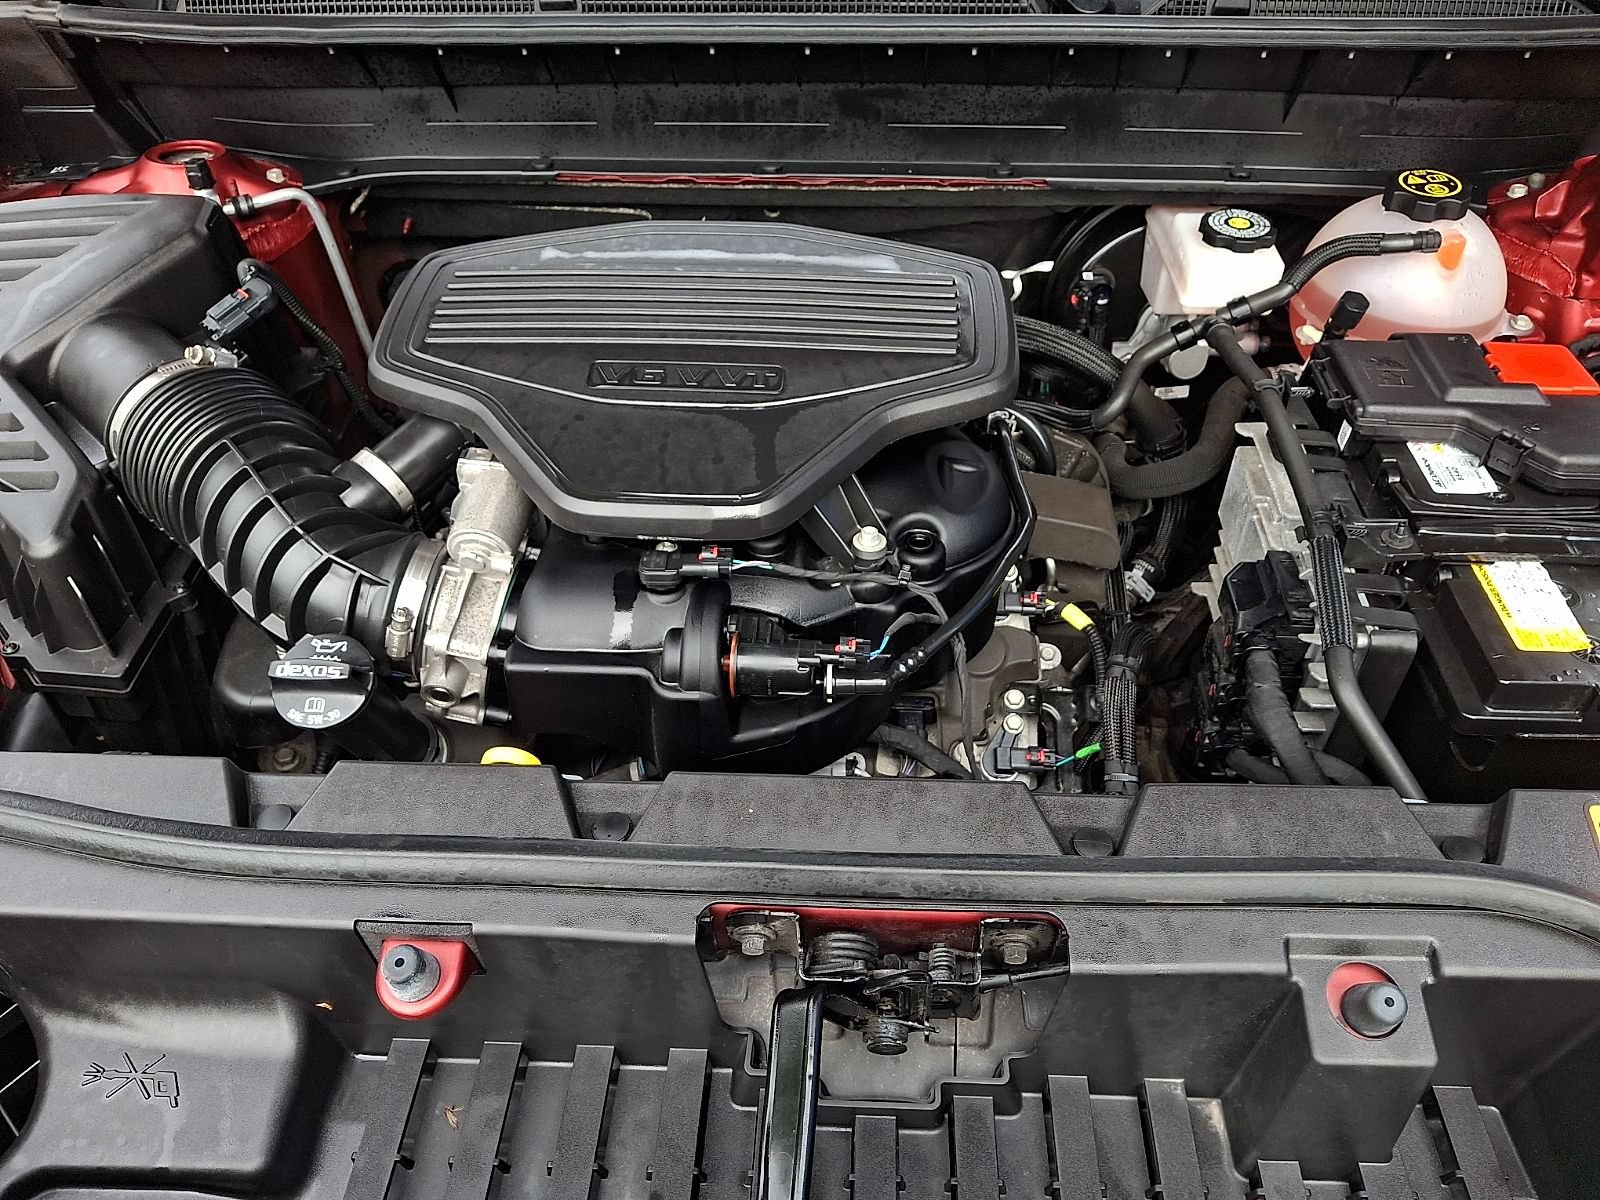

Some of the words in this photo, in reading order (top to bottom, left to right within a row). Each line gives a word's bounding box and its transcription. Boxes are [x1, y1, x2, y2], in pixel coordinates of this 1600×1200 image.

[597, 365, 666, 385] V6
[676, 366, 777, 388] VVT
[275, 660, 345, 679] dexos
[307, 708, 341, 725] 5W-30
